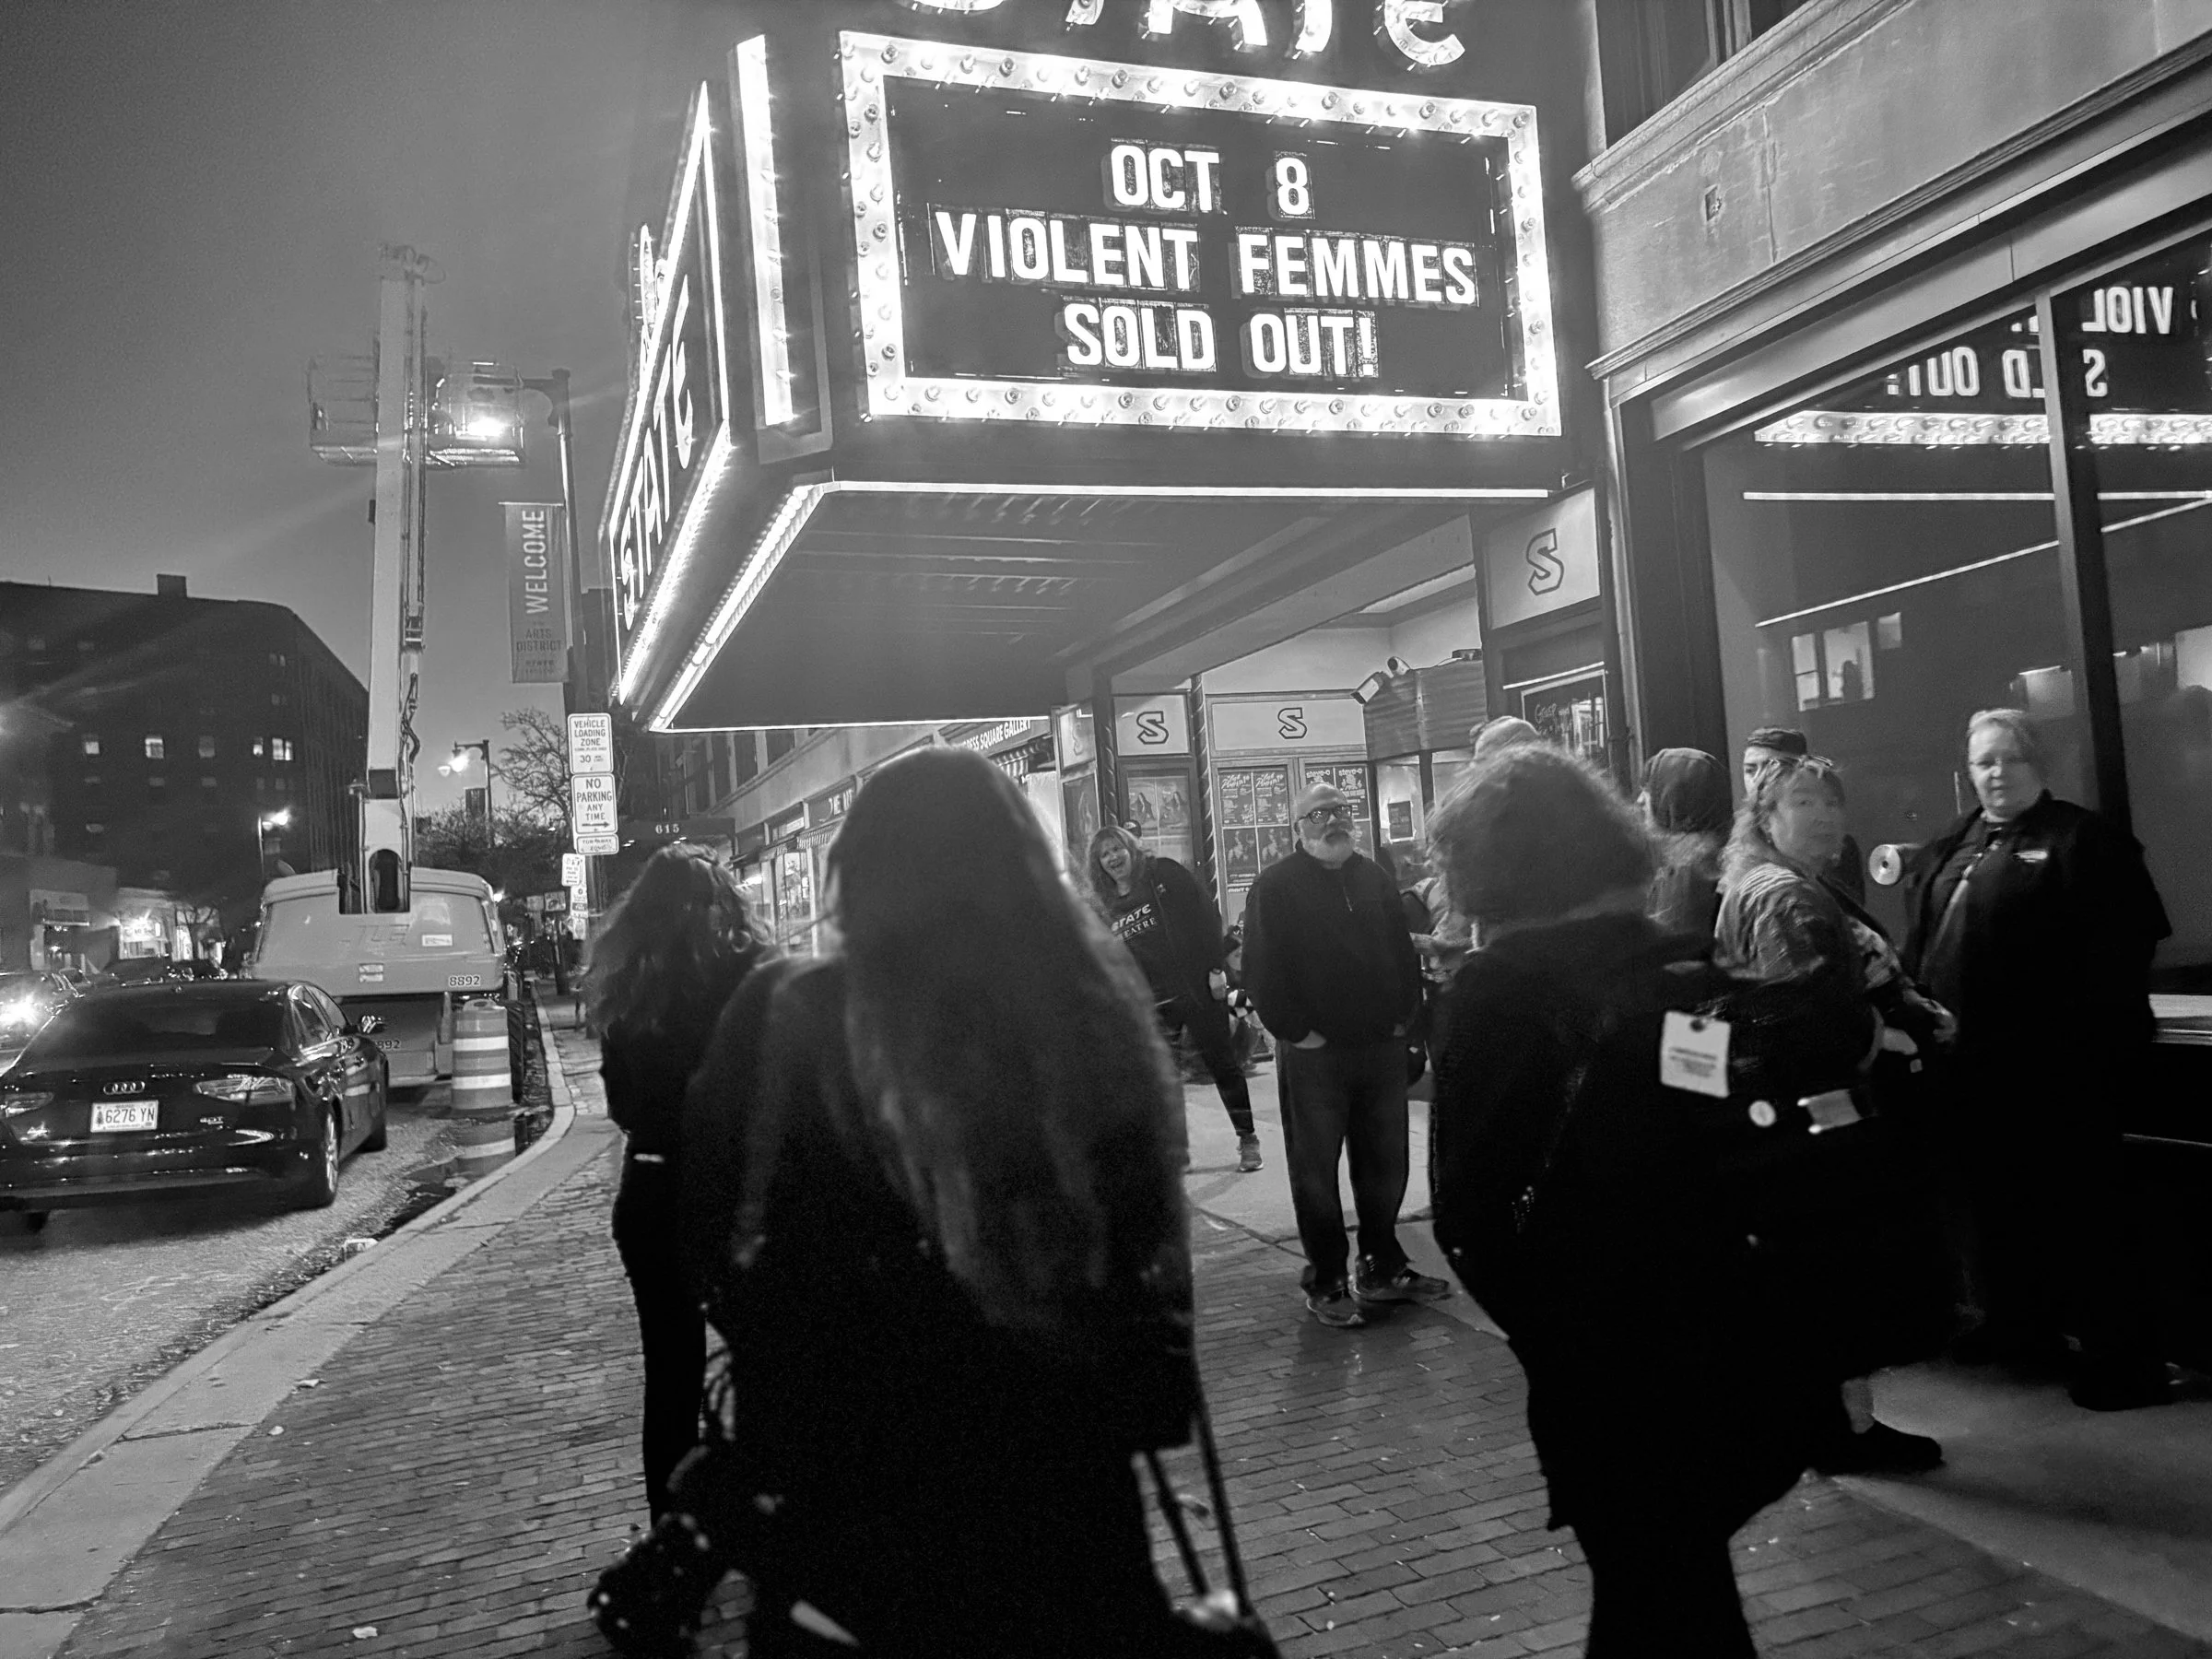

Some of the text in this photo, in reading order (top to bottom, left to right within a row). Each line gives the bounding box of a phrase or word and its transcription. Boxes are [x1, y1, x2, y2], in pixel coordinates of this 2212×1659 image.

[1111, 145, 1310, 216] OCT 8
[935, 211, 1477, 305] VIOLENT FEMMES
[1064, 302, 1376, 377] SOLD OUT!
[523, 511, 549, 614] WELCOME
[1526, 528, 1564, 595] S
[525, 629, 552, 640] ARTS
[516, 641, 562, 652] DISTRICT
[574, 720, 606, 728] VEHICLE
[1136, 711, 1169, 745] S
[1277, 707, 1307, 739] S
[574, 729, 606, 737] LOADING
[581, 737, 601, 747] ZONE
[580, 755, 592, 763] 30
[585, 779, 601, 789] NO
[576, 791, 613, 803] PARKING
[587, 804, 604, 812] ANY
[585, 812, 606, 820] TIME
[655, 823, 680, 834] 615
[449, 976, 480, 986] 8892
[377, 1040, 400, 1050] 892
[105, 1108, 155, 1124] 6276 YN
